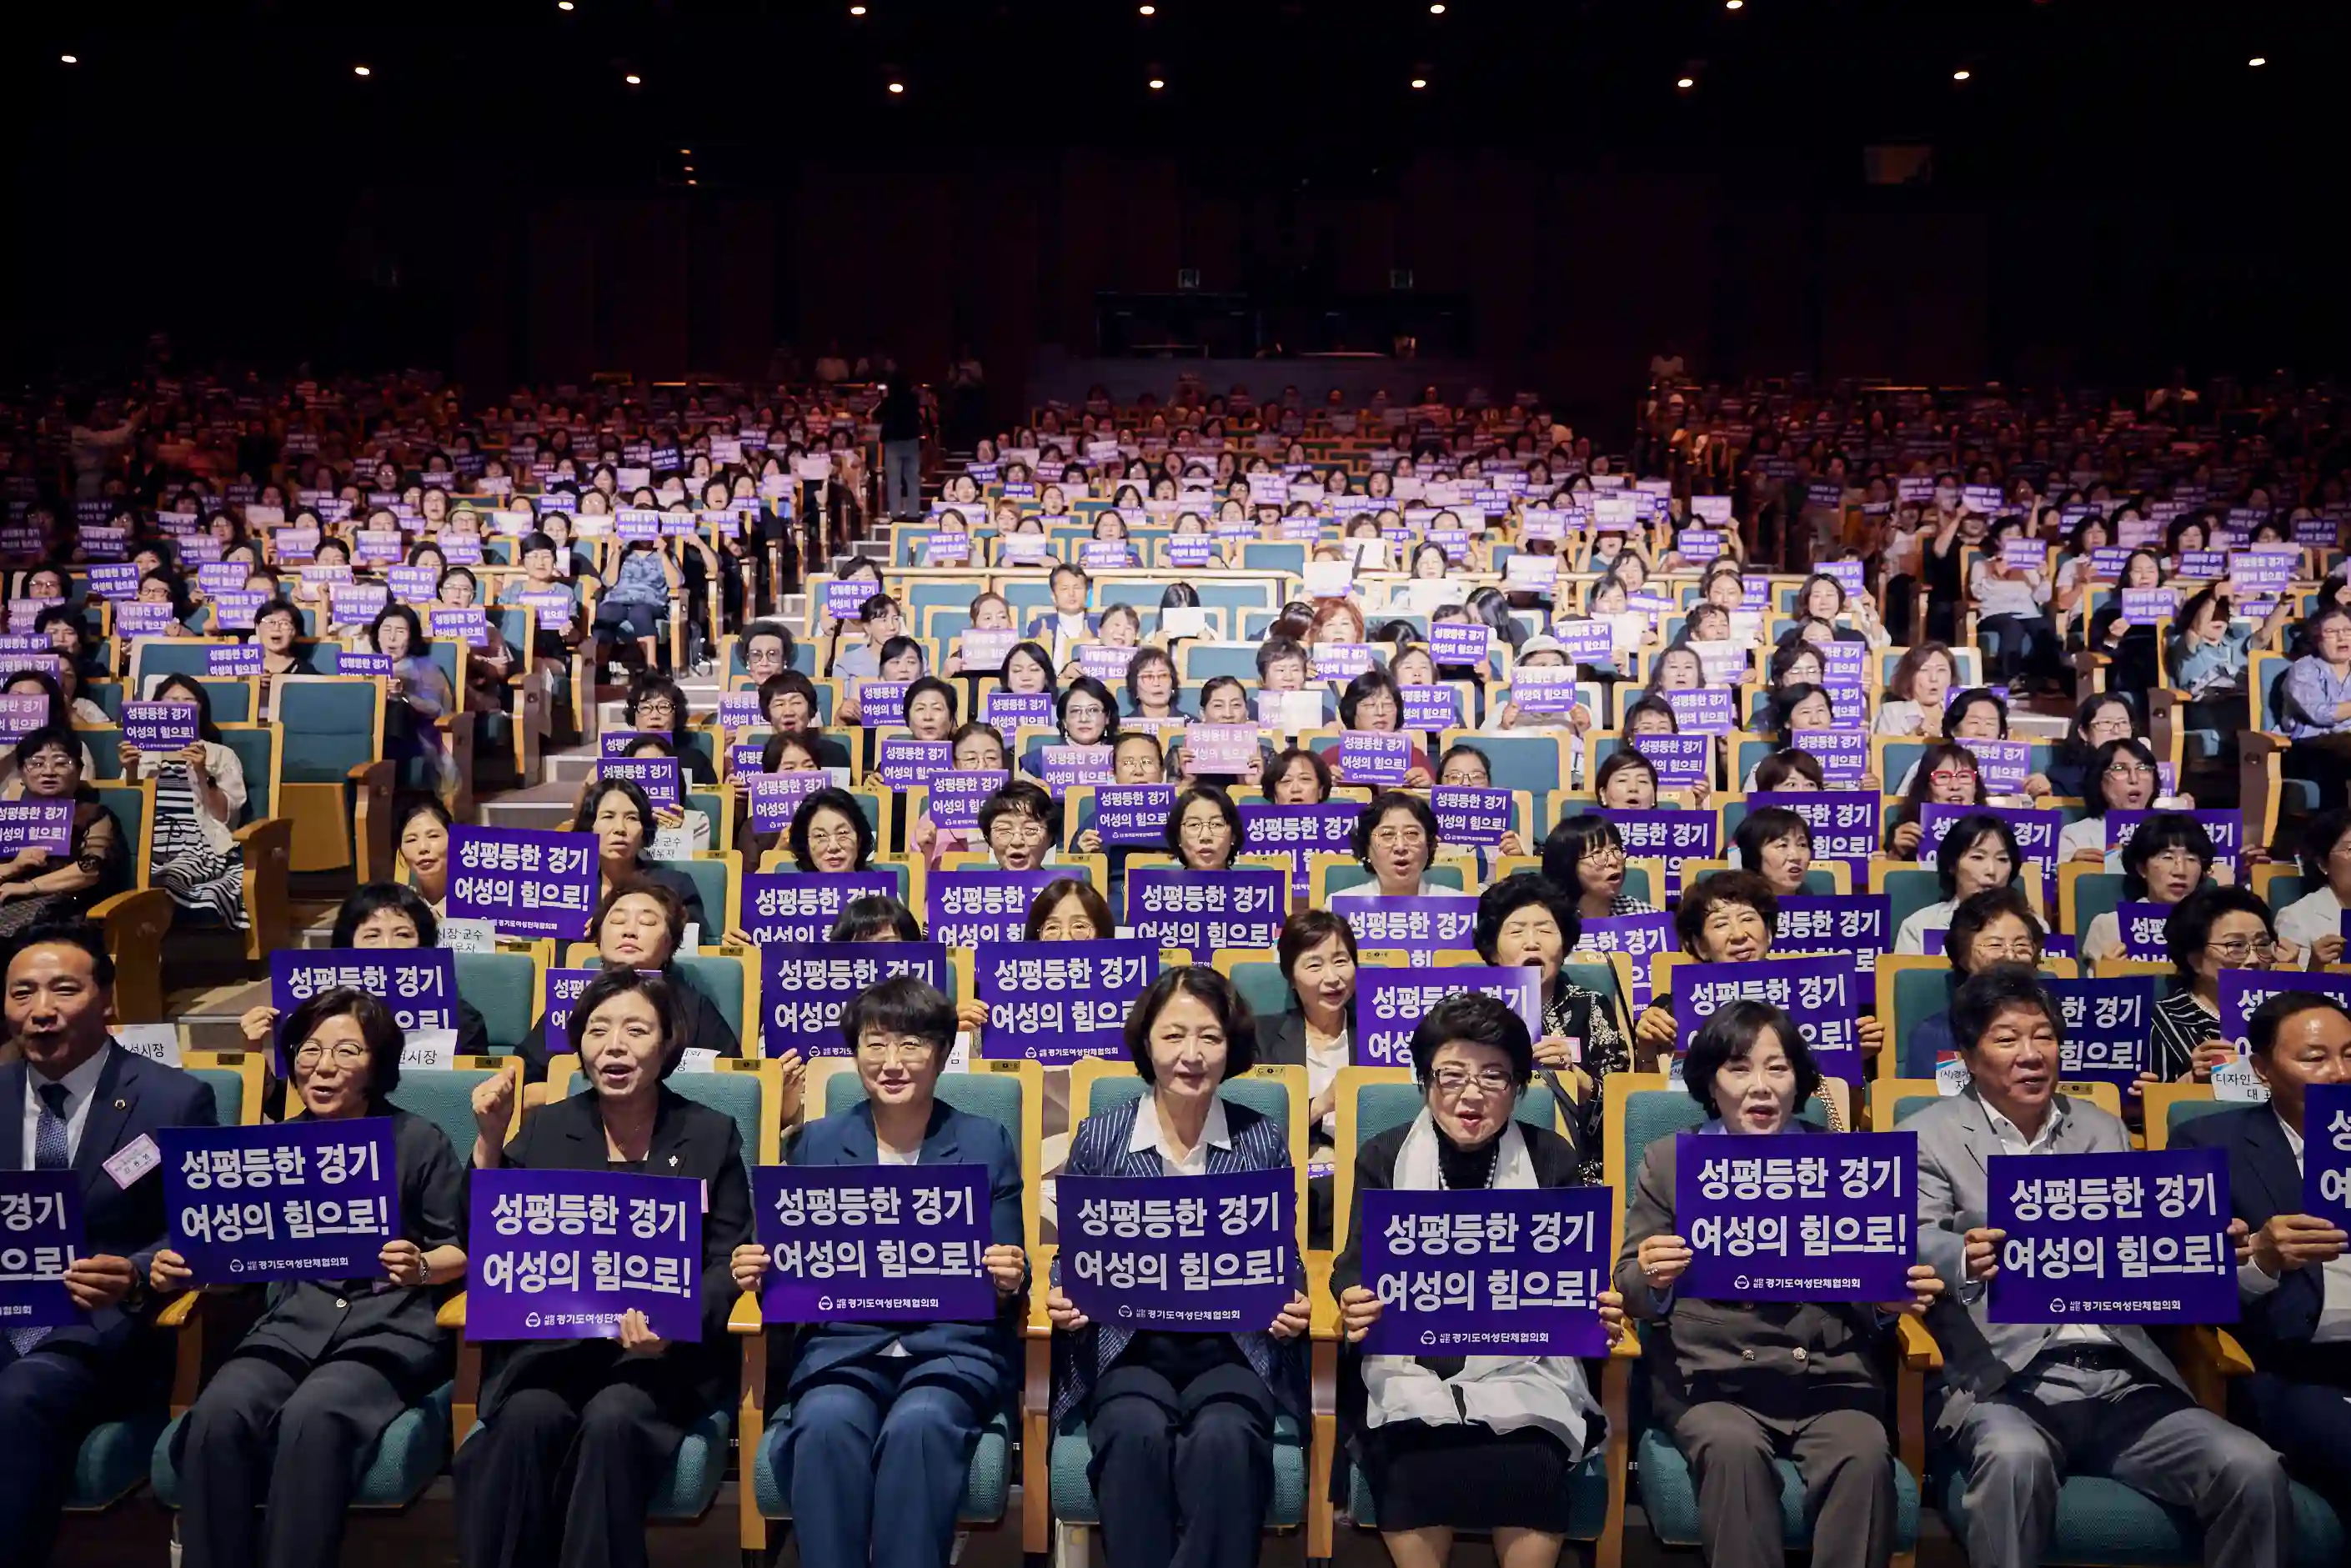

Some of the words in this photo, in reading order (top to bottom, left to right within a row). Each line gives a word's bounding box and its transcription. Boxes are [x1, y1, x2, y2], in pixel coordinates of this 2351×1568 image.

[862, 684, 899, 699] 성평등한
[1434, 690, 1450, 703] 경기
[23, 699, 42, 712] 경기
[128, 707, 168, 720] 성평등한
[171, 708, 191, 720] 경기
[861, 704, 889, 715] 여성의
[127, 726, 156, 739] 여성의
[160, 726, 193, 739] 힘으로!
[1344, 736, 1382, 749] 성평등한
[1386, 738, 1406, 751] 경기
[1841, 735, 1861, 748] 경기
[886, 747, 925, 760] 성평등한
[928, 748, 946, 760] 경기
[1087, 750, 1110, 764] 경기
[1640, 740, 1680, 754] 성평등한
[1683, 740, 1702, 754] 경기
[2004, 748, 2024, 760] 경기
[603, 764, 646, 779] 성평등한
[650, 764, 671, 779] 경기
[1342, 757, 1371, 769] 여성의
[1375, 758, 1406, 771] 힘으로!
[1670, 759, 1702, 772] 힘으로!
[1829, 755, 1862, 768] 힘으로!
[883, 766, 912, 782] 여성의
[934, 778, 977, 792] 성평등한
[981, 777, 1002, 791] 경기
[1044, 772, 1074, 786] 여성의
[757, 779, 800, 794] 성평등한
[805, 778, 825, 793] 경기
[757, 802, 789, 817] 여성의
[933, 799, 965, 814] 여성의
[1100, 792, 1144, 806] 성평등한
[1148, 791, 1169, 805] 경기
[1436, 793, 1481, 808] 성평등한
[1485, 795, 1506, 810] 경기
[45, 807, 67, 819] 경기
[1100, 814, 1131, 827] 여성의
[1836, 804, 1871, 827] 경기
[29, 827, 66, 840] 힘으로!
[1247, 817, 1319, 841] 성평등한
[1470, 816, 1508, 834] 힘으로!
[1673, 824, 1707, 846] 경기
[2013, 823, 2051, 847] 경기
[460, 841, 541, 871] 성평등한
[548, 847, 588, 874] 경기
[1813, 836, 1872, 859] 힘으로!
[455, 877, 514, 906] 여성의
[521, 881, 589, 911] 힘으로!
[755, 888, 840, 915] 성평등한
[941, 886, 1025, 914] 성평등한
[1141, 885, 1226, 912] 성평등한
[1233, 886, 1273, 912] 경기
[1348, 912, 1430, 939] 성평등한
[1437, 912, 1477, 939] 경기
[1839, 909, 1879, 937] 경기
[1139, 922, 1199, 948] 여성의
[1622, 927, 1668, 957] 경기
[396, 966, 443, 997] 경기
[778, 959, 878, 990] 성평등한
[995, 958, 1092, 990] 성평등한
[1100, 955, 1146, 988] 경기
[1799, 974, 1845, 1009] 경기
[775, 1002, 847, 1032] 여성의
[992, 1002, 1063, 1033] 여성의
[2094, 995, 2141, 1028] 경기
[2060, 1039, 2142, 1071] 힘으로!
[181, 1146, 305, 1189] 성평등한
[317, 1141, 378, 1184] 경기
[1697, 1158, 1828, 1200] 성평등한
[1839, 1156, 1900, 1198] 경기
[774, 1187, 901, 1225] 성평등한
[912, 1187, 973, 1225] 경기
[2010, 1177, 2144, 1220] 성평등한
[2155, 1173, 2216, 1217] 경기
[1, 1192, 66, 1230] 경기
[182, 1202, 274, 1242] 여성의
[283, 1196, 388, 1238] 힘으로!
[491, 1194, 619, 1235] 성평등한
[629, 1199, 685, 1241] 경기
[1078, 1198, 1207, 1238] 성평등한
[1218, 1192, 1278, 1235] 경기
[1384, 1213, 1519, 1255] 성평등한
[1530, 1211, 1594, 1253] 경기
[1689, 1216, 1787, 1256] 여성의
[1800, 1215, 1906, 1255] 힘으로!
[0, 1245, 77, 1283] 으로!
[258, 1257, 348, 1270] 경기도여성단체협의회
[774, 1240, 865, 1278] 여성의
[877, 1240, 985, 1277] 힘으로!
[2004, 1237, 2103, 1279] 여성의
[2117, 1233, 2225, 1277] 힘으로!
[484, 1251, 579, 1293] 여성의
[592, 1250, 690, 1298] 힘으로!
[1075, 1250, 1166, 1290] 여성의
[1180, 1246, 1284, 1290] 힘으로!
[1375, 1270, 1474, 1311] 여성의
[1488, 1269, 1597, 1310] 힘으로!
[1766, 1279, 1860, 1288] 경기도여성단체협의회
[848, 1299, 938, 1308] 경기도여성단체협의회
[1148, 1310, 1240, 1320] 경기도여성단체협의회
[2083, 1300, 2180, 1311] 경기도여성단체협의회
[1452, 1333, 1548, 1343] 경기도여성단체협의회
